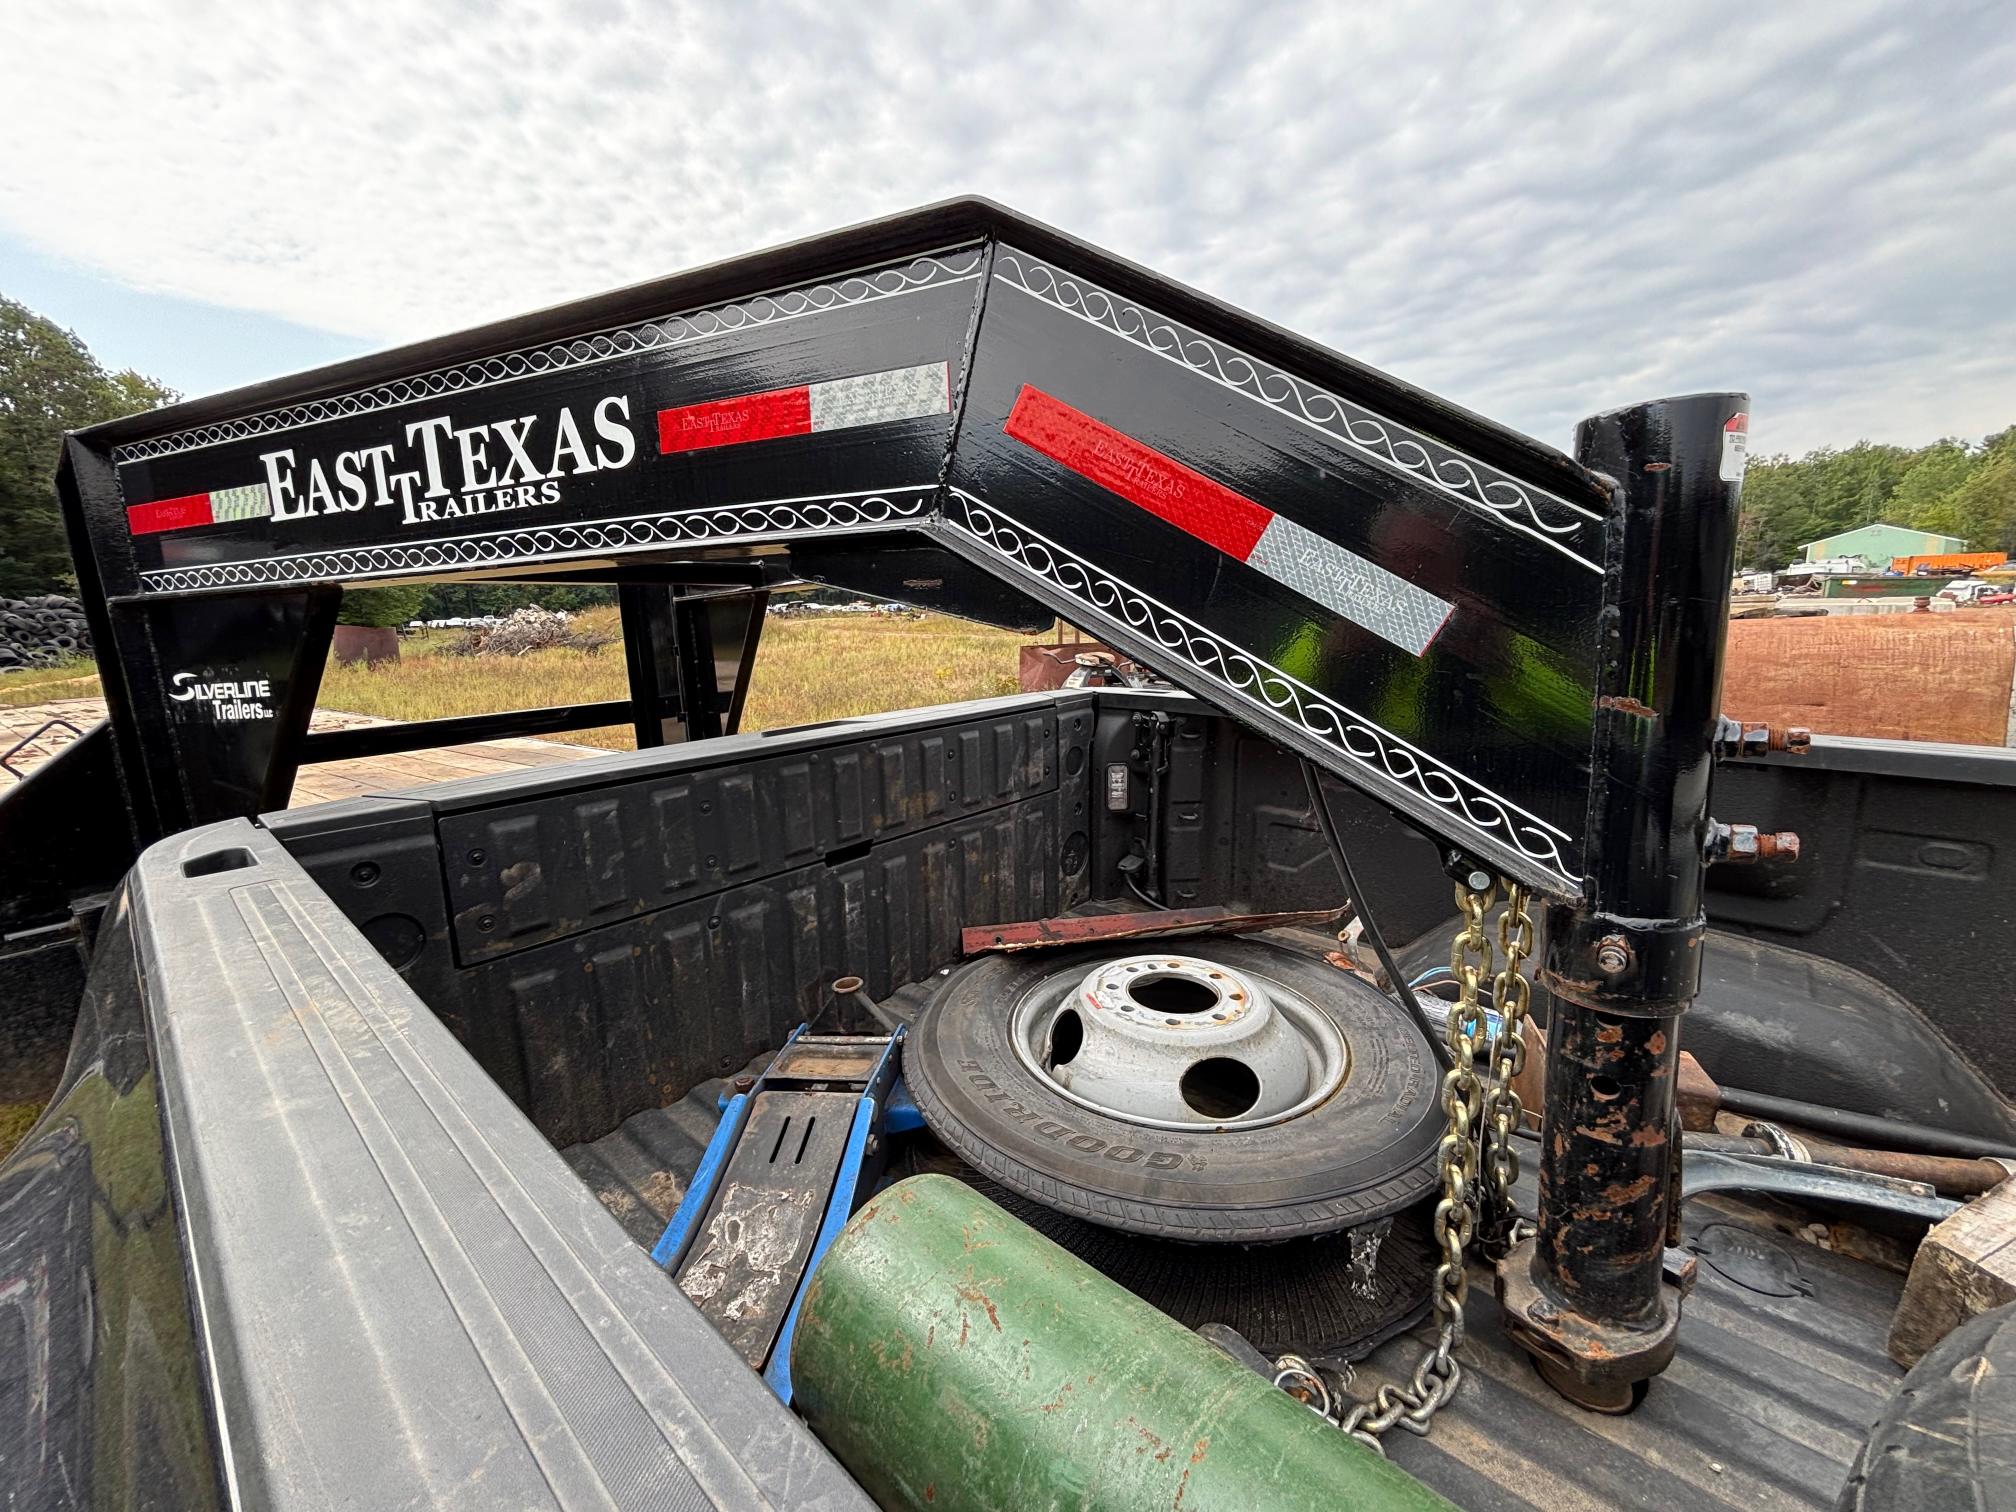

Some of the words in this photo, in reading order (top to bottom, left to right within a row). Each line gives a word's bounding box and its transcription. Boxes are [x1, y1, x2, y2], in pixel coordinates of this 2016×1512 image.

[681, 415, 709, 431] EAST
[711, 410, 749, 426] TEXAS
[259, 444, 397, 523] EAST
[404, 395, 636, 499] TEXAS
[1093, 440, 1134, 470] EAST
[1136, 461, 1186, 499] TEXAS
[389, 471, 562, 525] TRAILERS
[1125, 465, 1168, 499] TRAILERS
[1351, 573, 1408, 614] TEXAS
[168, 672, 271, 701] SILVERLINE
[212, 699, 264, 720] Trailers
[957, 1059, 1185, 1170] GOODRIDE
